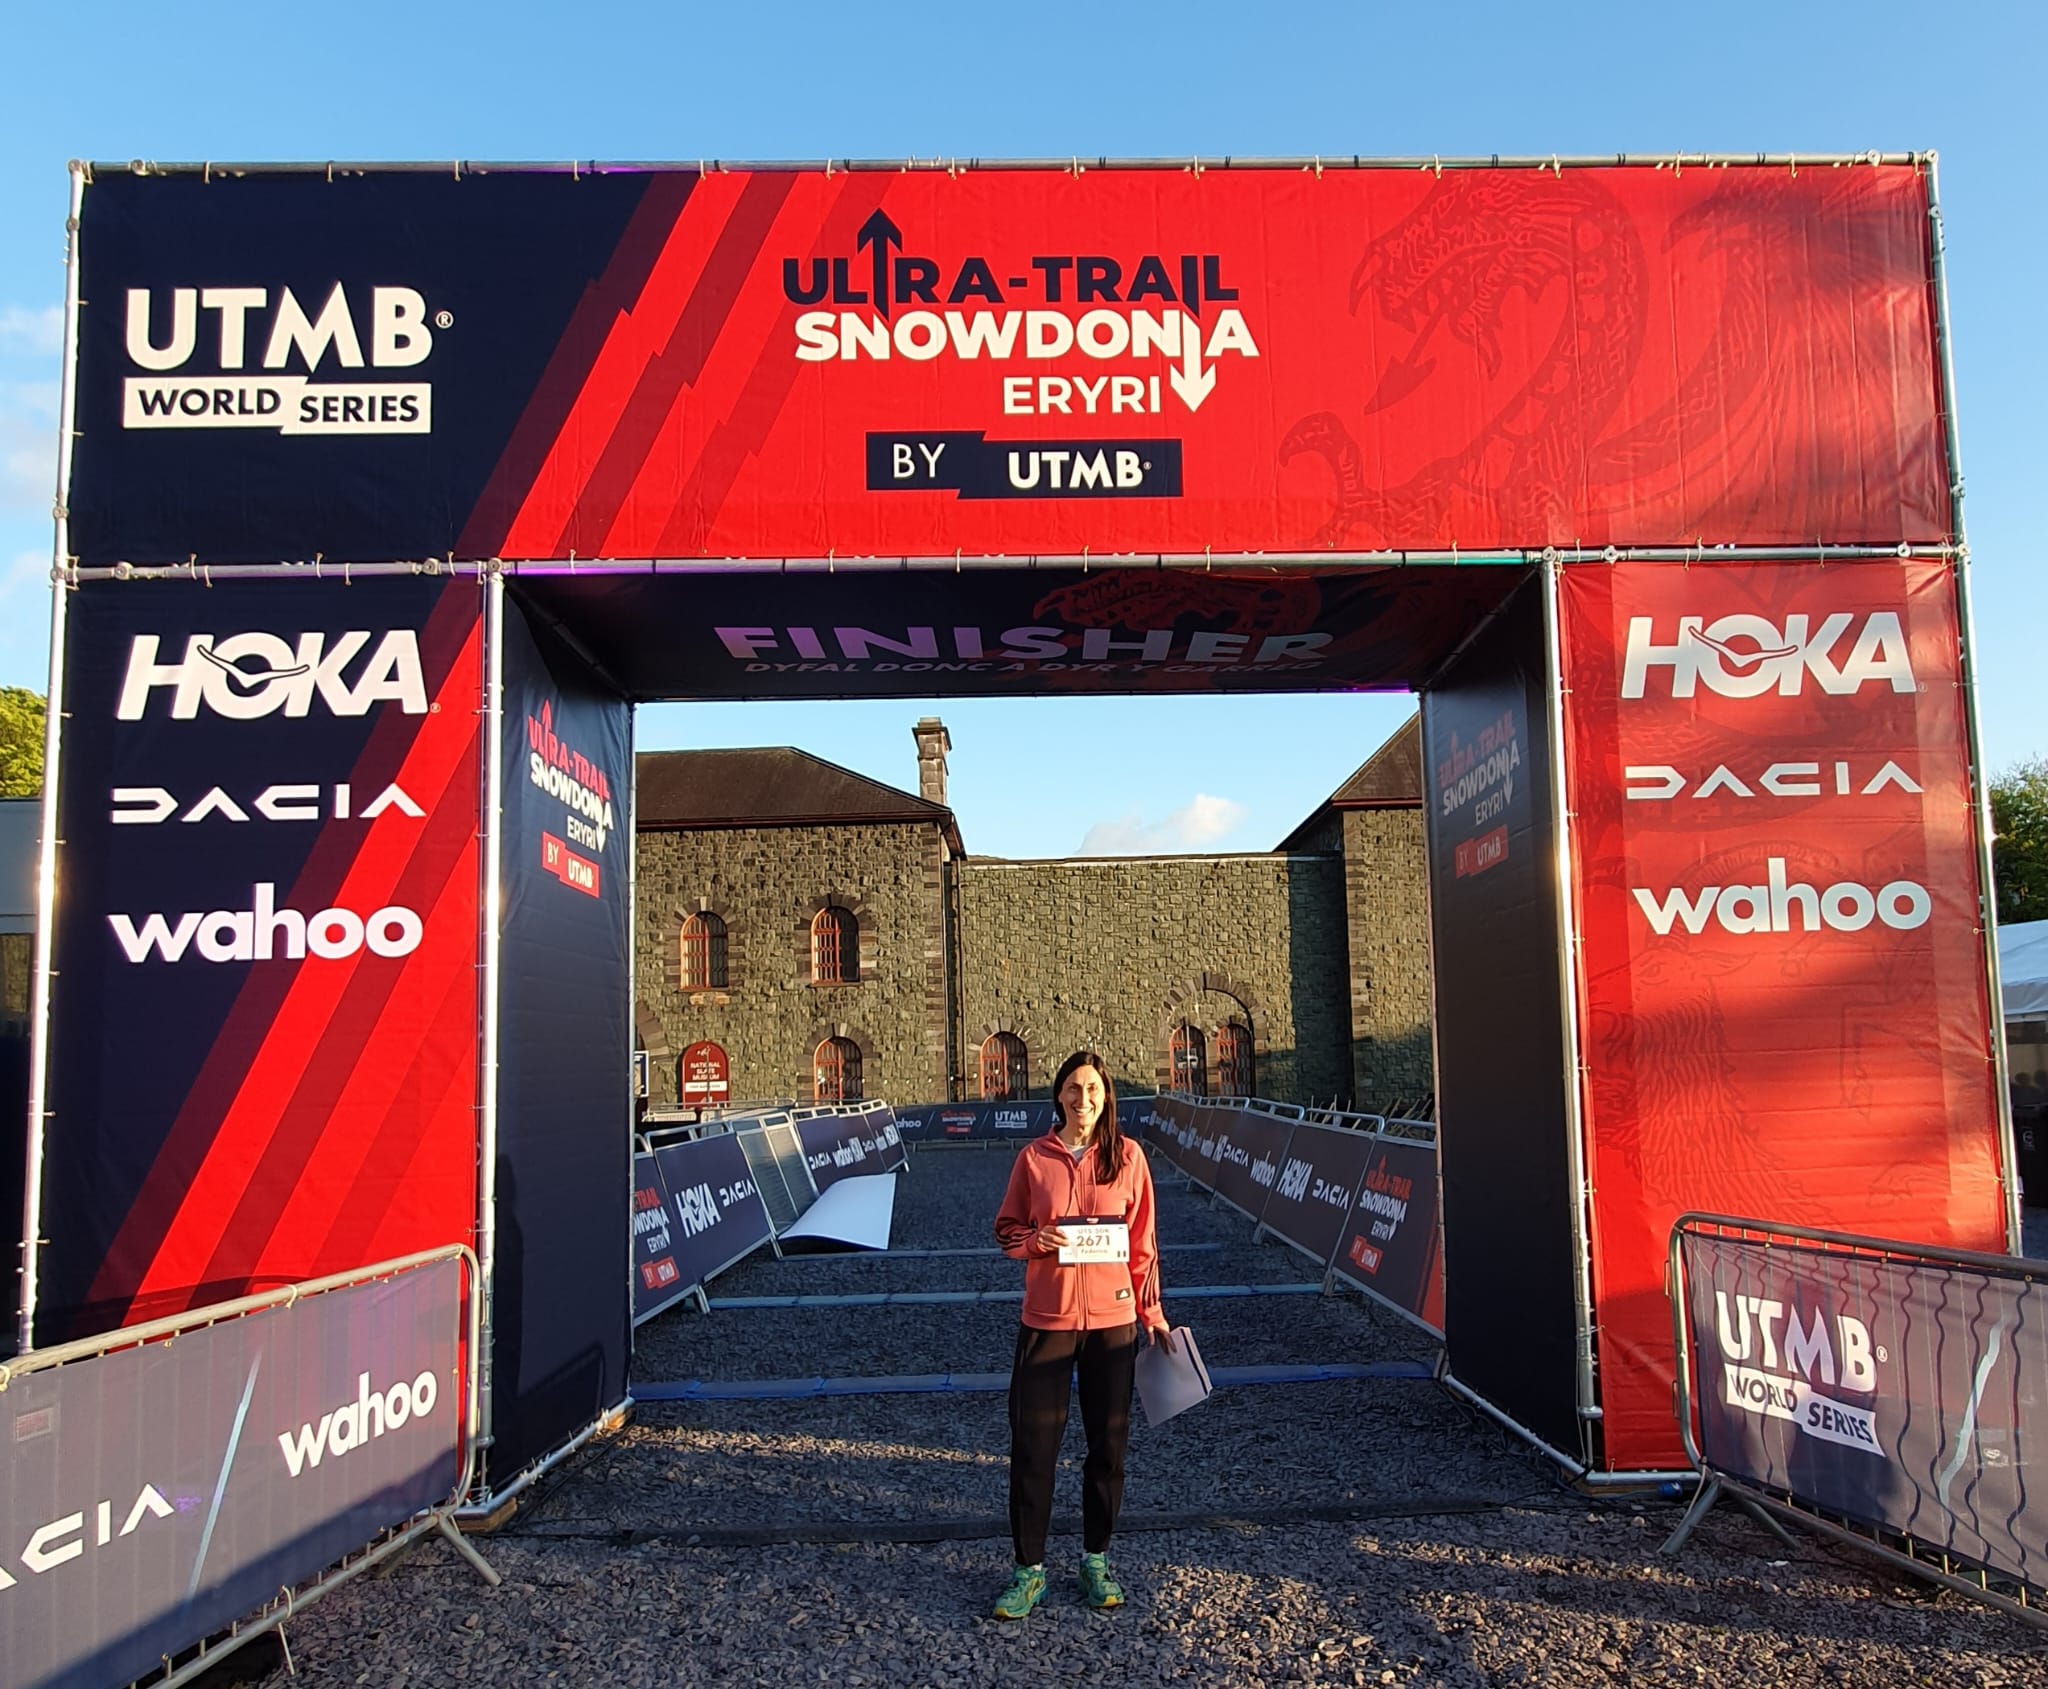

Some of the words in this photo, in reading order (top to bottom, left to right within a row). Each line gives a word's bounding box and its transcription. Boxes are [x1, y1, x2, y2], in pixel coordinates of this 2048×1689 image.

[794, 308, 1260, 412] SNOWDONIA
[139, 388, 281, 417] WORLD
[299, 395, 420, 422] SERIES
[1003, 376, 1160, 414] ERYRI
[893, 443, 945, 479] BY
[714, 626, 1335, 664] FINISHER
[1621, 611, 1917, 699] HOKA
[116, 629, 428, 720] HOKA
[744, 663, 860, 672] DYFAL
[872, 663, 993, 672] DONC
[998, 663, 1025, 672] A
[1038, 663, 1118, 672] DYR
[1130, 665, 1156, 673] Y
[1443, 739, 1520, 816] SNOWDONIA
[1624, 760, 1924, 800] DACIA
[111, 783, 427, 823] DACIA
[530, 752, 614, 853] SNOWDONIA
[1475, 789, 1504, 826] ERYRI
[567, 815, 596, 850] ERYRI
[1477, 836, 1501, 866] UTMB
[547, 842, 559, 865] BY
[1632, 857, 1932, 936] wahoo
[107, 882, 423, 963] wahoo
[675, 1182, 722, 1239] HOKA
[719, 1178, 756, 1208] DACIA
[1076, 1235, 1110, 1247] 2671
[278, 1371, 438, 1478] wahoo
[1730, 1372, 1799, 1413] WORLD
[1807, 1401, 1875, 1444] SERIES
